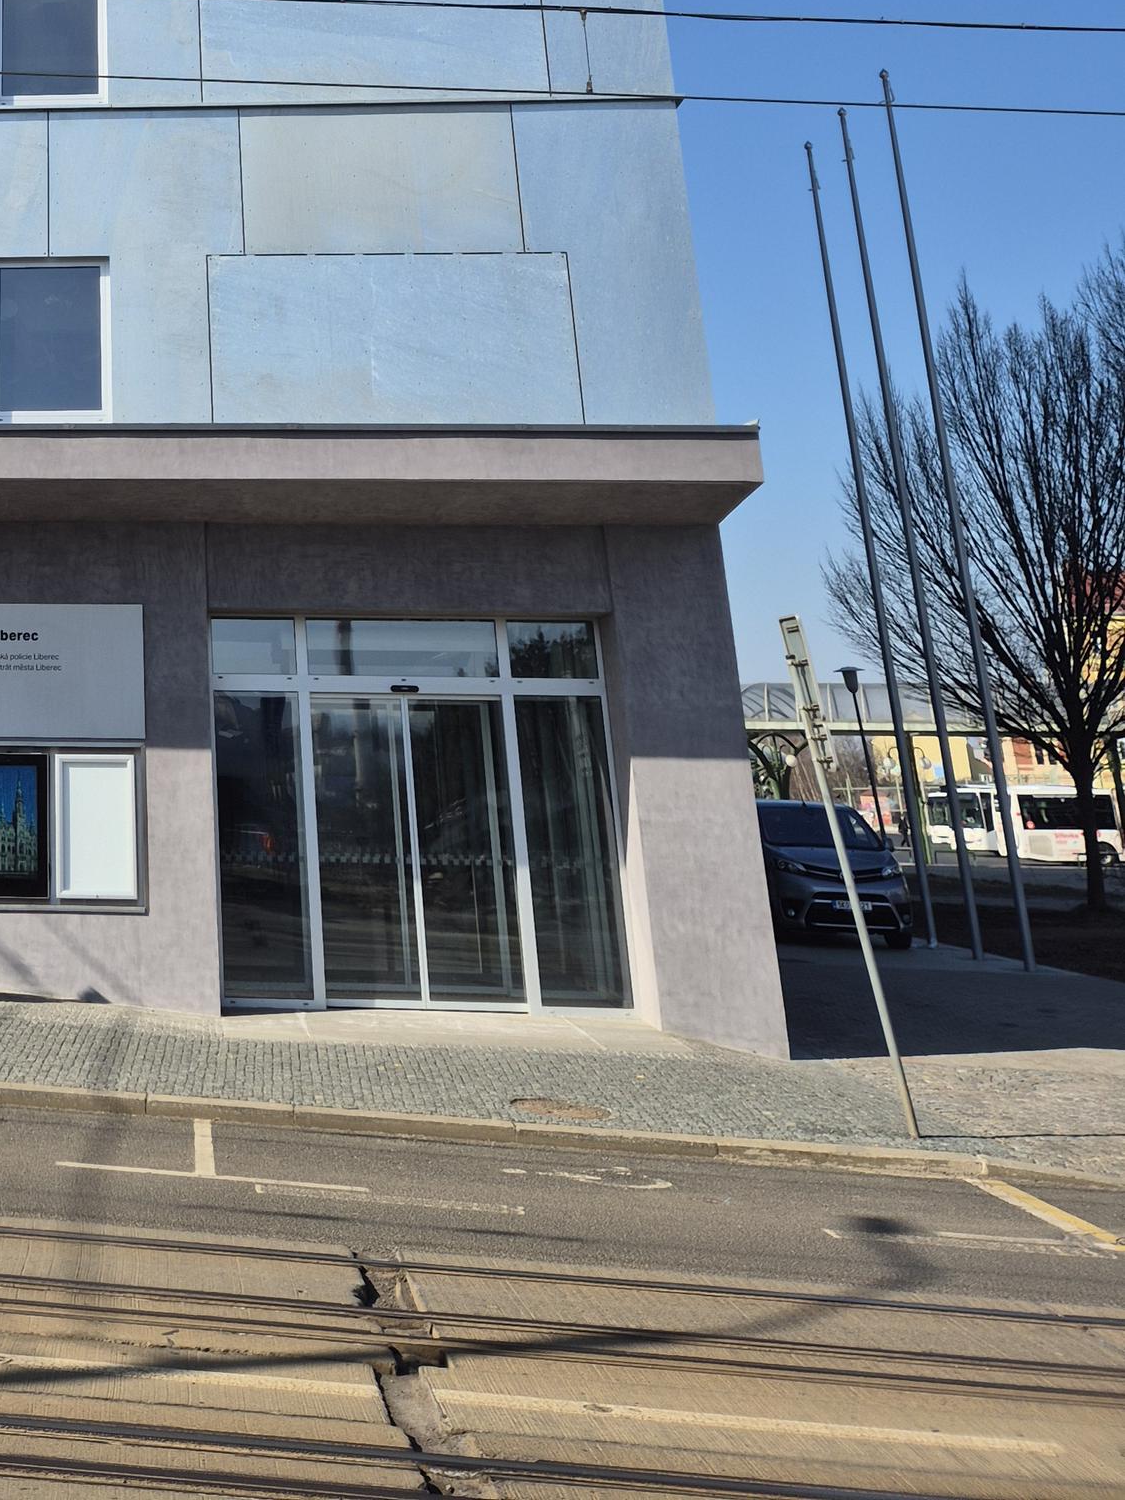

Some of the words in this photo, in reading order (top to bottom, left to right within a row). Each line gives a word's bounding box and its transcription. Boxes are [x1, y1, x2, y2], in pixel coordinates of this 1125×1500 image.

[10, 653, 33, 661] policie
[13, 663, 35, 671] města
[36, 663, 62, 671] Liberec
